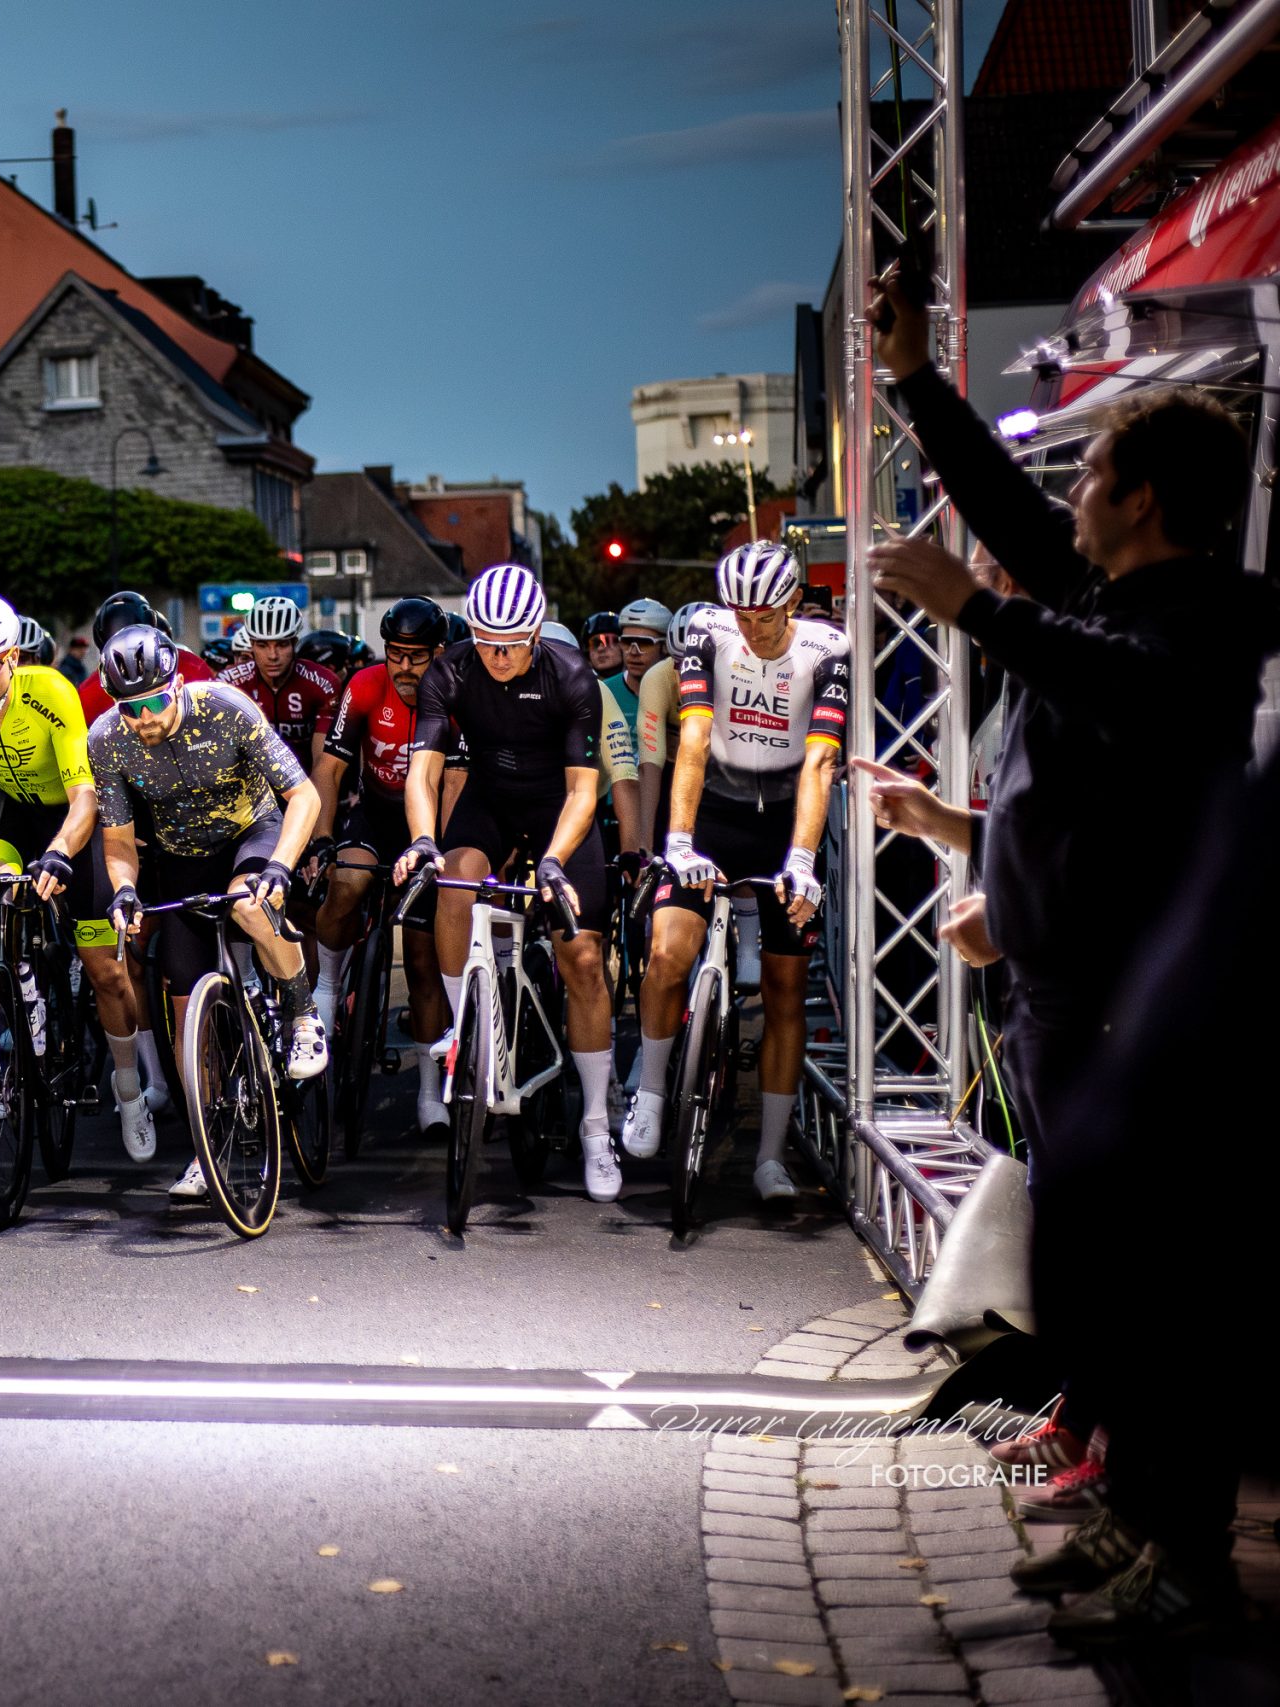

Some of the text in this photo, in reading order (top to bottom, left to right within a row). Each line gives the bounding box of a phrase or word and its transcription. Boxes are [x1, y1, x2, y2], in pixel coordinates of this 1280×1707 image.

[730, 687, 790, 717] UAE
[29, 699, 66, 730] GIANT
[734, 711, 784, 728] Emirates
[728, 729, 790, 748] XRG
